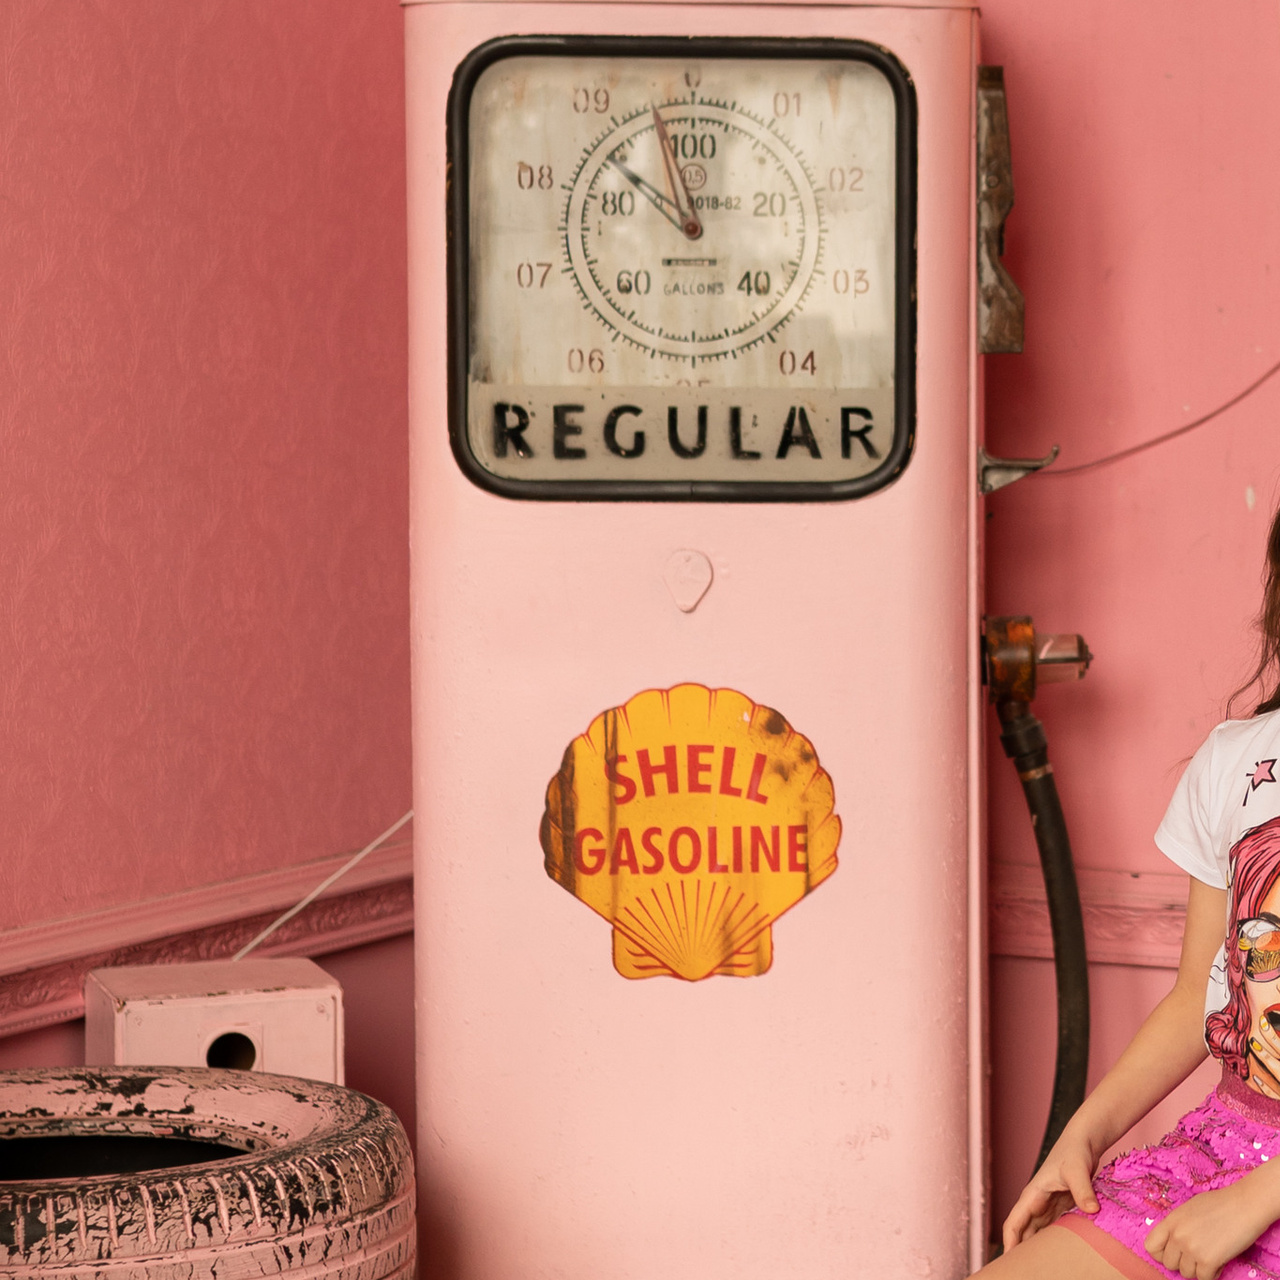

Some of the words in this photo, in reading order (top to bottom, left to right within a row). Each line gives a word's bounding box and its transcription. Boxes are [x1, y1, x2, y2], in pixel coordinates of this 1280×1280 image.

[572, 87, 609, 114] 09
[773, 91, 802, 118] 01
[670, 134, 717, 159] 100
[517, 164, 554, 191] 08
[829, 167, 864, 193] 02
[602, 190, 635, 216] 80
[753, 191, 787, 217] 20
[517, 262, 553, 288] 07
[617, 270, 651, 296] 60
[737, 271, 771, 296] 40
[833, 269, 870, 296] 03
[664, 282, 725, 296] GALLONS
[568, 349, 605, 374] 06
[780, 350, 817, 376] 04
[494, 403, 881, 460] REGULAR
[604, 744, 769, 806] SHELL
[572, 825, 809, 876] GASOLINE
